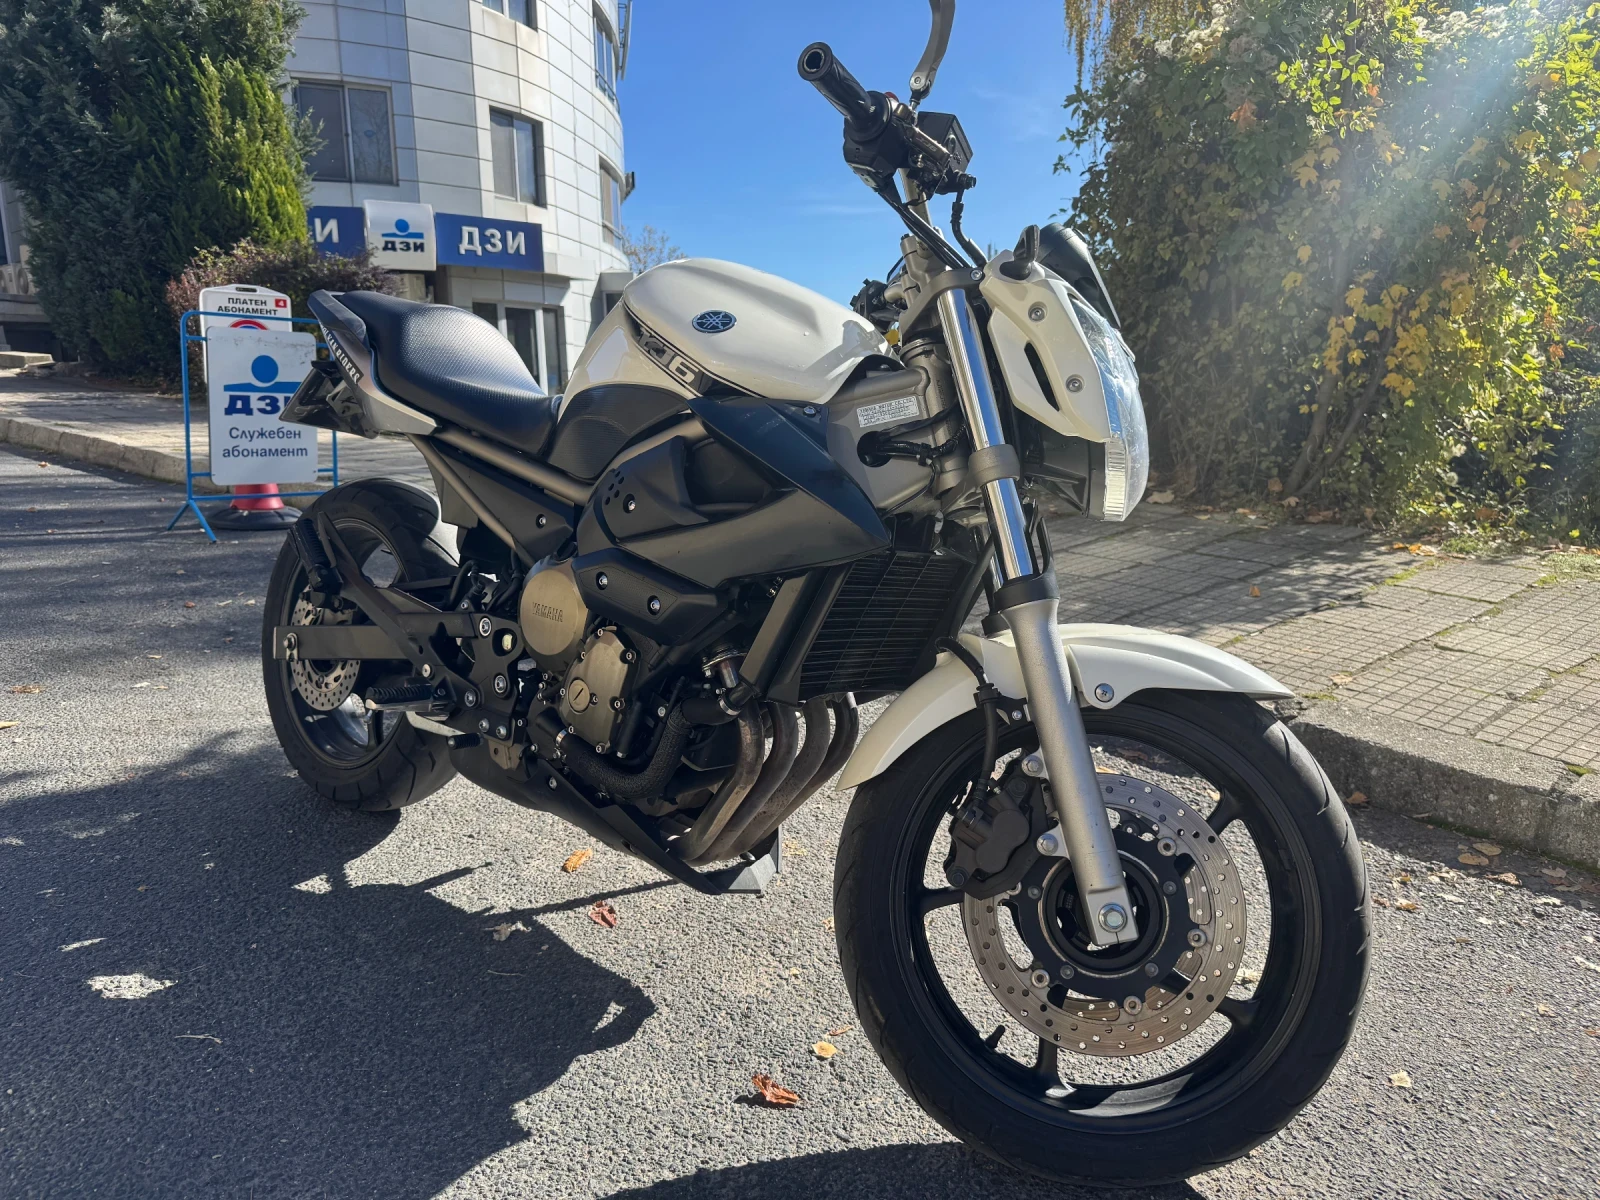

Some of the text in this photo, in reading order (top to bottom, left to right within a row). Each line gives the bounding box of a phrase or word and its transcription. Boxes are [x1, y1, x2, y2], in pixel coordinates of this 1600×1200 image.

[382, 240, 425, 253] ДЗИ
[458, 225, 526, 257] ДЗИ
[228, 297, 267, 307] ПЛАТЕН
[217, 305, 278, 316] АБОНАМЕНТ
[336, 348, 360, 384] RIDERS
[229, 427, 301, 442] Служебен
[222, 445, 308, 458] абонамент
[532, 601, 563, 622] YAMAHA
